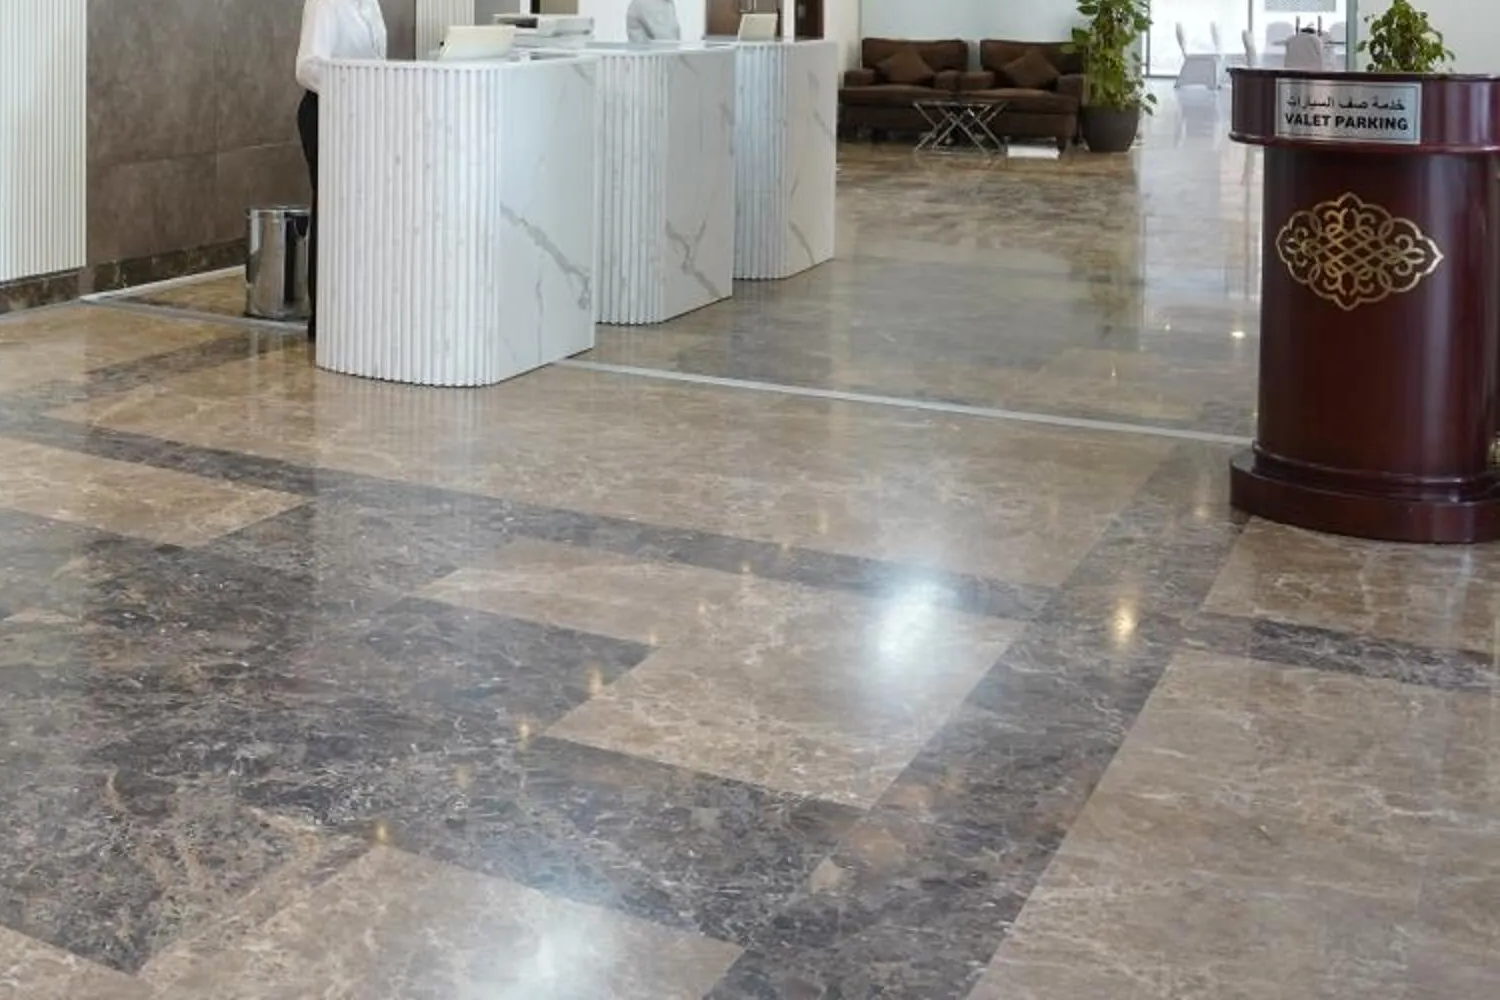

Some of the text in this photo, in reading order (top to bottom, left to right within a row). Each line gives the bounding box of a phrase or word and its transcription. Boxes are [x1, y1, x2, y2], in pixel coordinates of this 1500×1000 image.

[1286, 95, 1405, 111] خدمة صف السيارات
[1285, 113, 1408, 131] VALET PARKING
